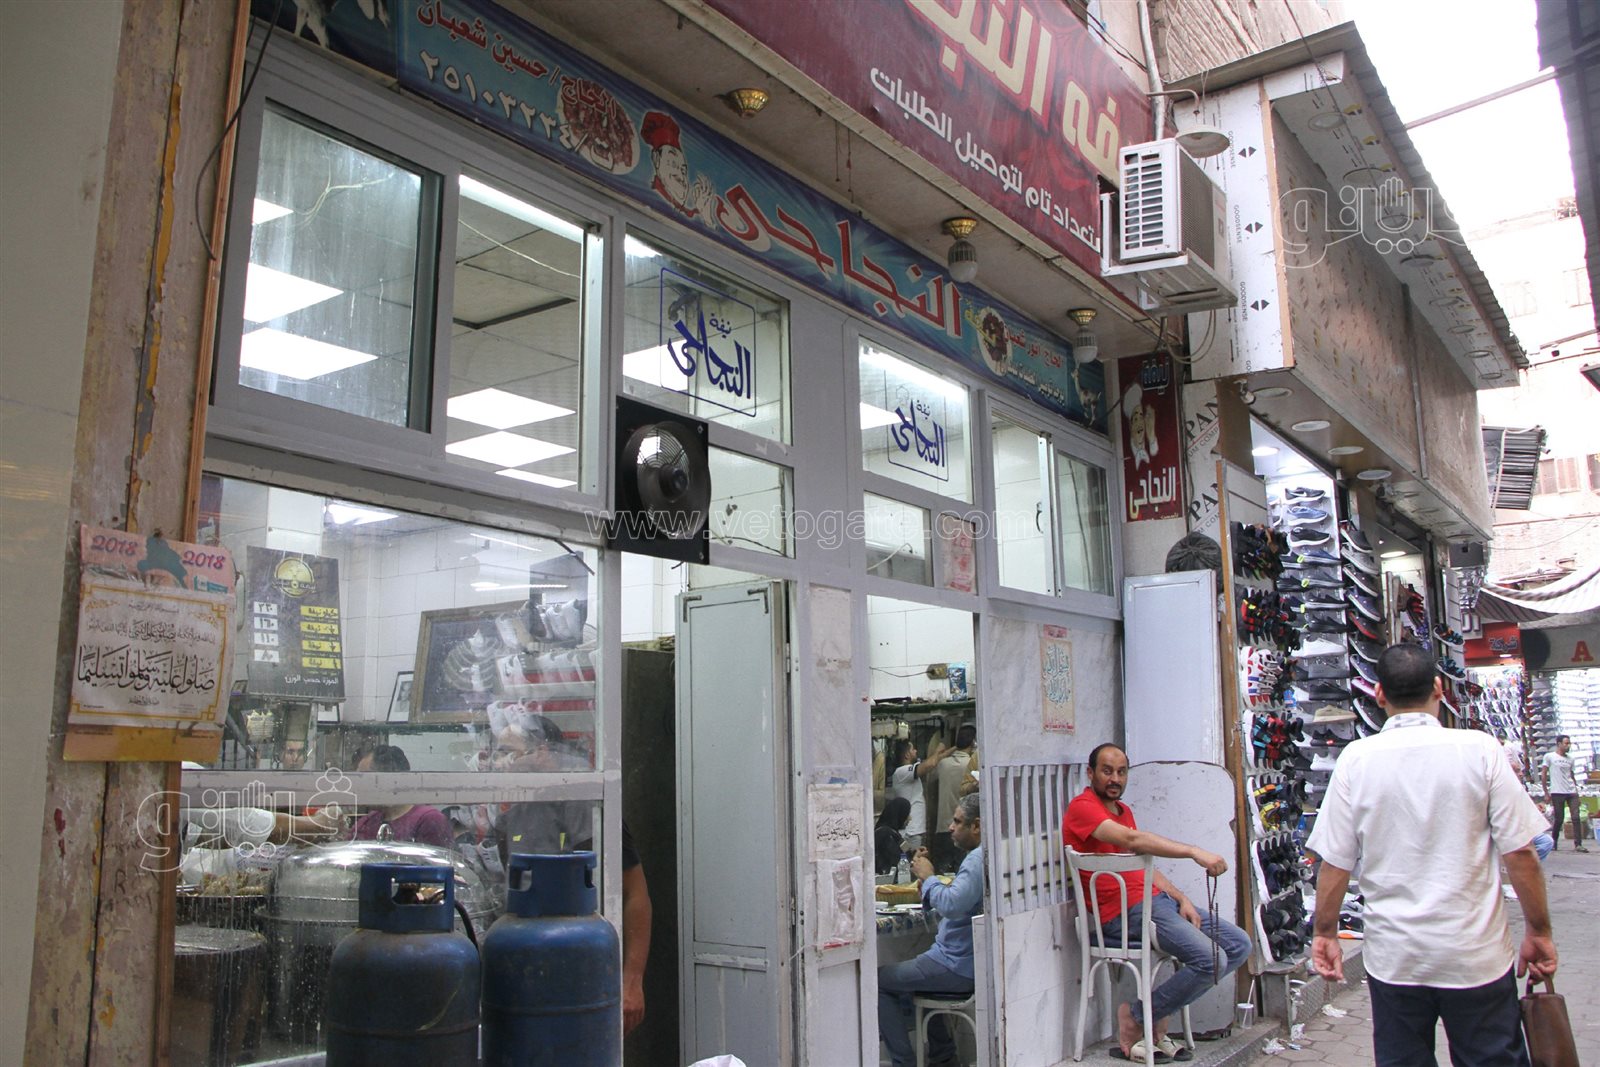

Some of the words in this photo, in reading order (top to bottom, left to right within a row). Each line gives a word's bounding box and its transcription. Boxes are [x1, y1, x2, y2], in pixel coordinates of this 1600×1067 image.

[417, 0, 488, 49] شعبان
[492, 35, 548, 78] حسين
[870, 67, 952, 142] الطلبات
[955, 132, 1023, 195] لتوصيل
[1025, 186, 1052, 216] تام
[1234, 204, 1242, 243] GOODSENSE
[1240, 281, 1248, 321] GOODSENSE
[709, 313, 732, 339] نيفة
[91, 535, 139, 557] 2018
[182, 550, 226, 570] 2018
[1489, 636, 1518, 653] شركة
[1571, 640, 1594, 662] A
